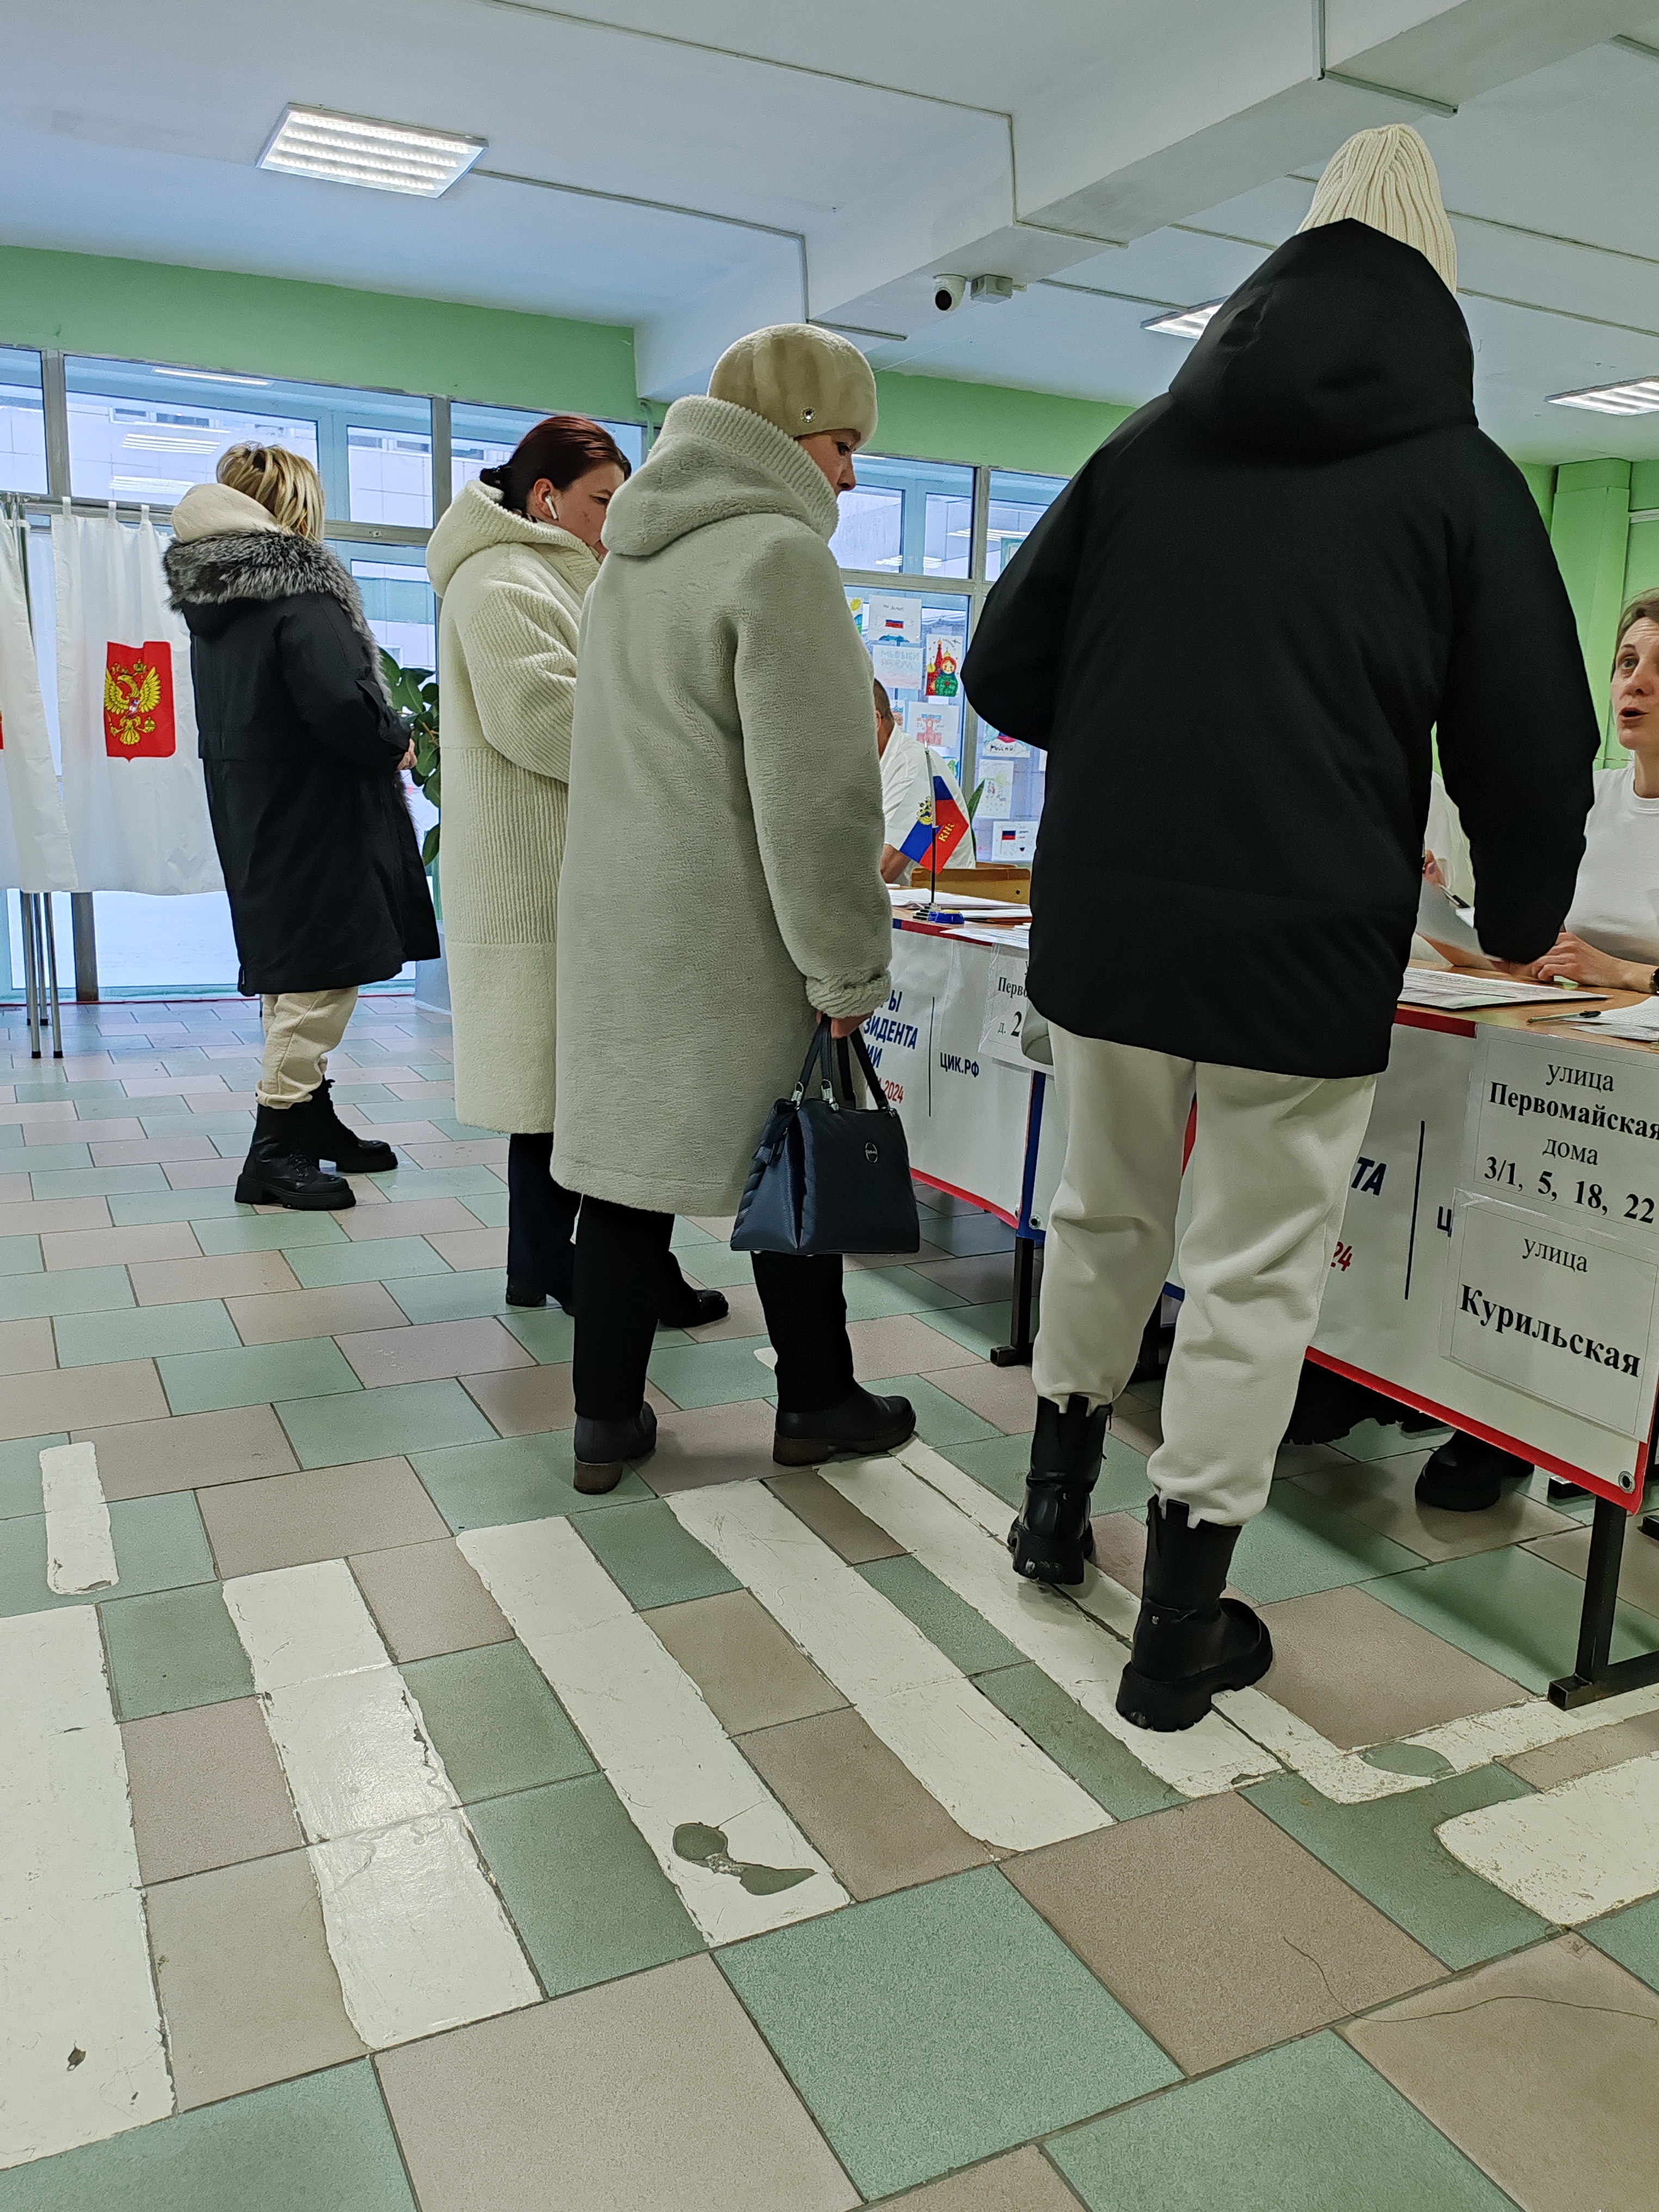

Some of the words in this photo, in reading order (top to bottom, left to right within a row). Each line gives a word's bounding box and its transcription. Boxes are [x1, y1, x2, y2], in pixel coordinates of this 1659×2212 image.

[998, 976, 1028, 998] Перво
[863, 1016, 918, 1050] ЗИДЕНТА
[998, 1022, 1006, 1034] д.
[867, 1044, 883, 1068] ИИ
[941, 1052, 979, 1078] ЦИК.РФ
[884, 1079, 904, 1104] 2024
[1545, 1064, 1614, 1093] улица
[1488, 1081, 1659, 1141] Первомайская
[1541, 1138, 1599, 1166] дома
[1351, 1157, 1387, 1196] ТА
[1484, 1156, 1523, 1192] 3/1,
[1537, 1170, 1557, 1202] 5,
[1573, 1181, 1608, 1216] 18,
[1623, 1194, 1655, 1224] 22
[1437, 1206, 1452, 1238] Ц
[1330, 1242, 1353, 1271] 24
[1522, 1238, 1588, 1273] улица
[1458, 1283, 1641, 1378] Курильская
